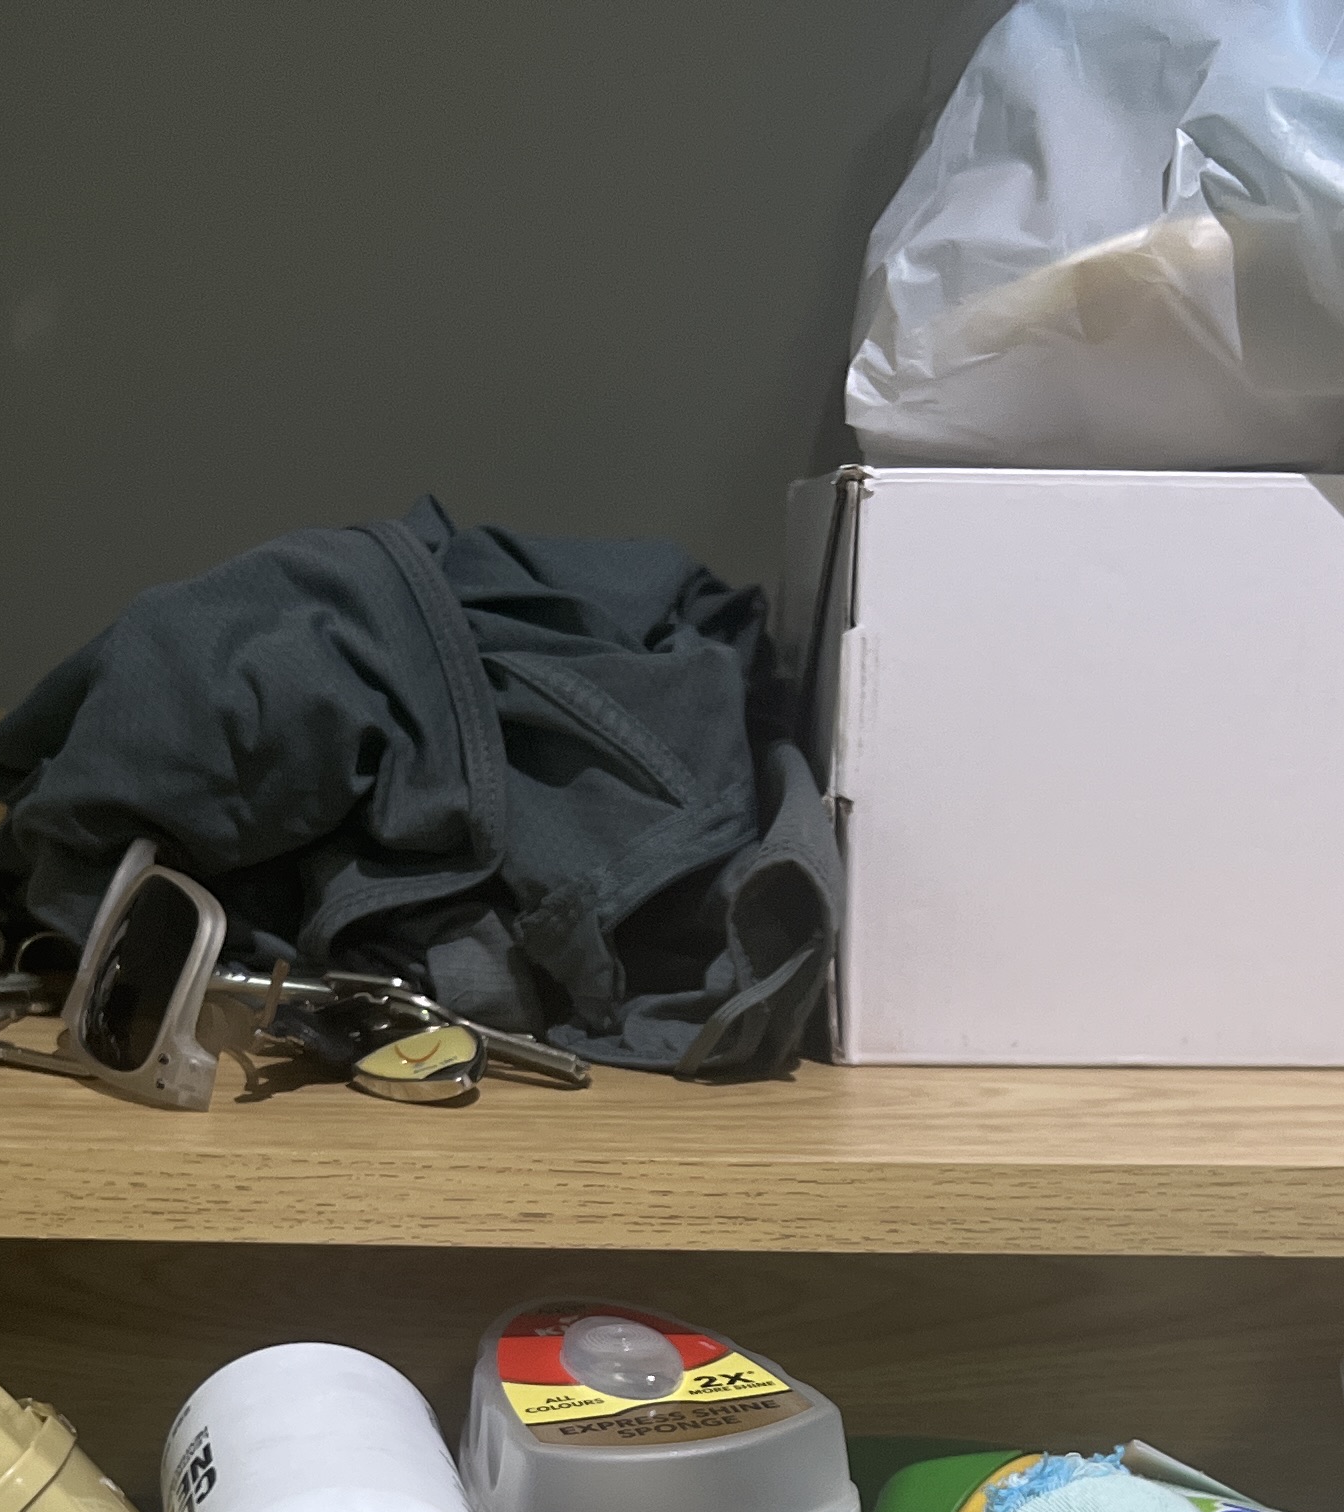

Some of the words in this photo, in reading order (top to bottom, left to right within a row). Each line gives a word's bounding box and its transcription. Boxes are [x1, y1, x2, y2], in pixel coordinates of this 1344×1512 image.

[688, 1386, 732, 1396] MORE
[736, 1380, 776, 1391] SHINE
[525, 1397, 605, 1414] COLOURS
[545, 1395, 575, 1404] ALL
[559, 1411, 686, 1436] EXPRESS
[693, 1400, 780, 1417] SHINE
[617, 1415, 742, 1438] SPONGE
